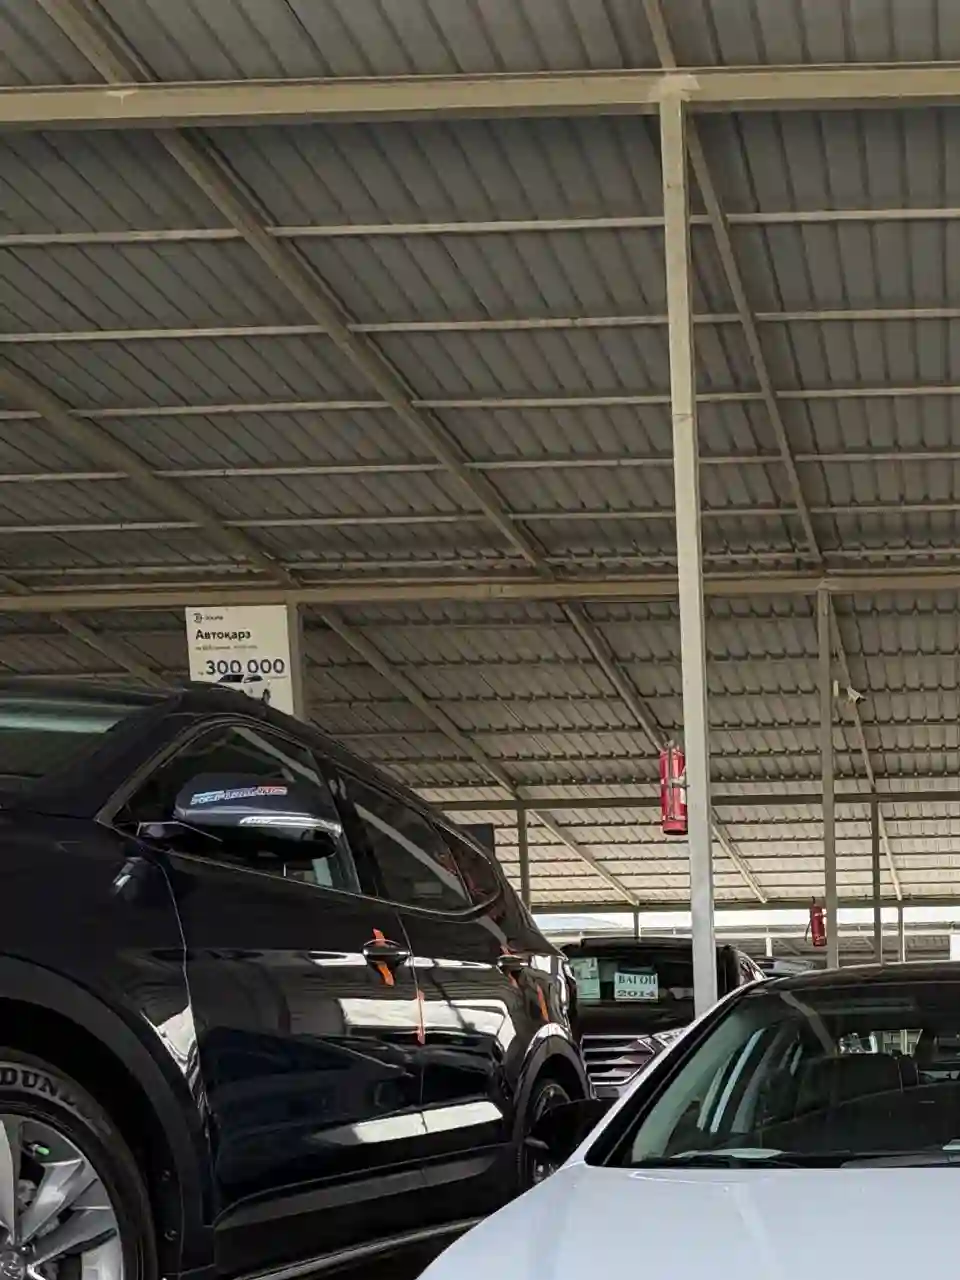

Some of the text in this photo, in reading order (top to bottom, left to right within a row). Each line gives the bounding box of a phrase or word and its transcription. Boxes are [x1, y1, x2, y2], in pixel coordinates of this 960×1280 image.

[195, 629, 251, 641] Автоқарз
[206, 658, 285, 675] 300 000
